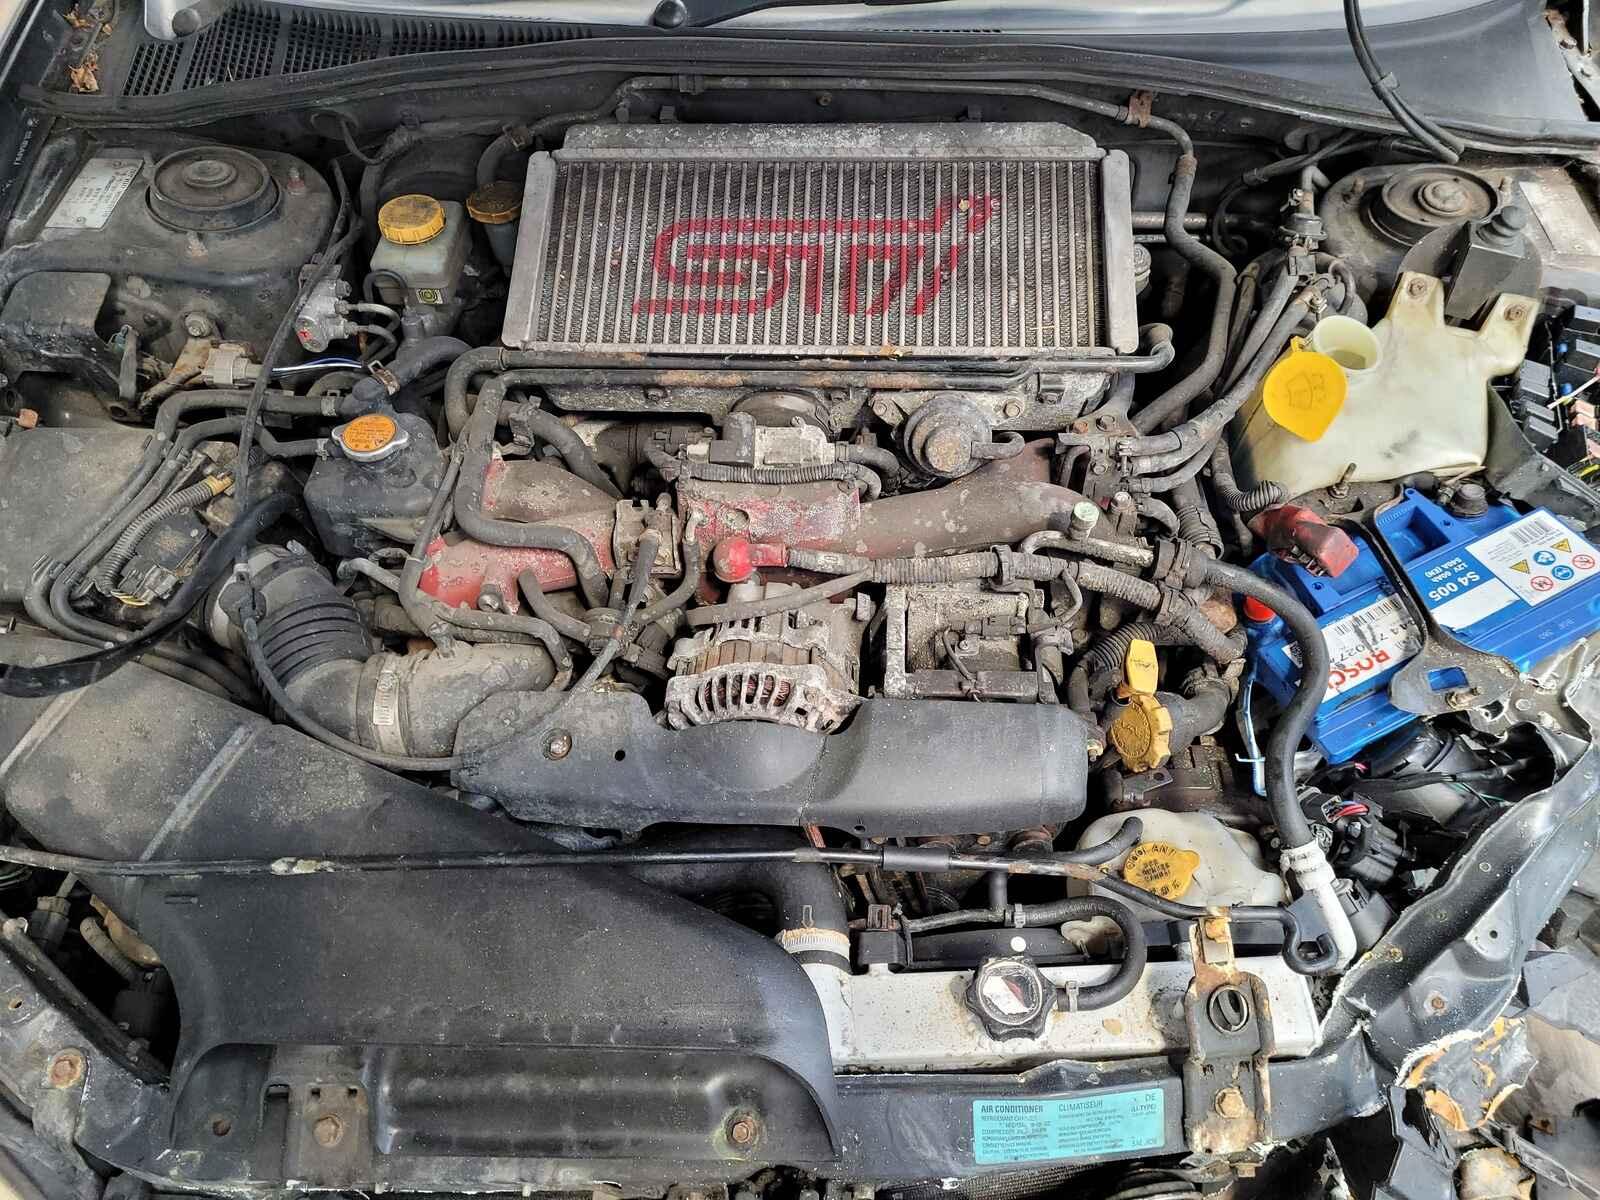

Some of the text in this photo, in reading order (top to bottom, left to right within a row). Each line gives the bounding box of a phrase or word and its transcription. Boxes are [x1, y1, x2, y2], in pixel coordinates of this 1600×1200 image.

[1429, 571, 1481, 601] S4 005
[1328, 648, 1391, 689] BOSC
[981, 1104, 1043, 1113] AIR CONDITIONER
